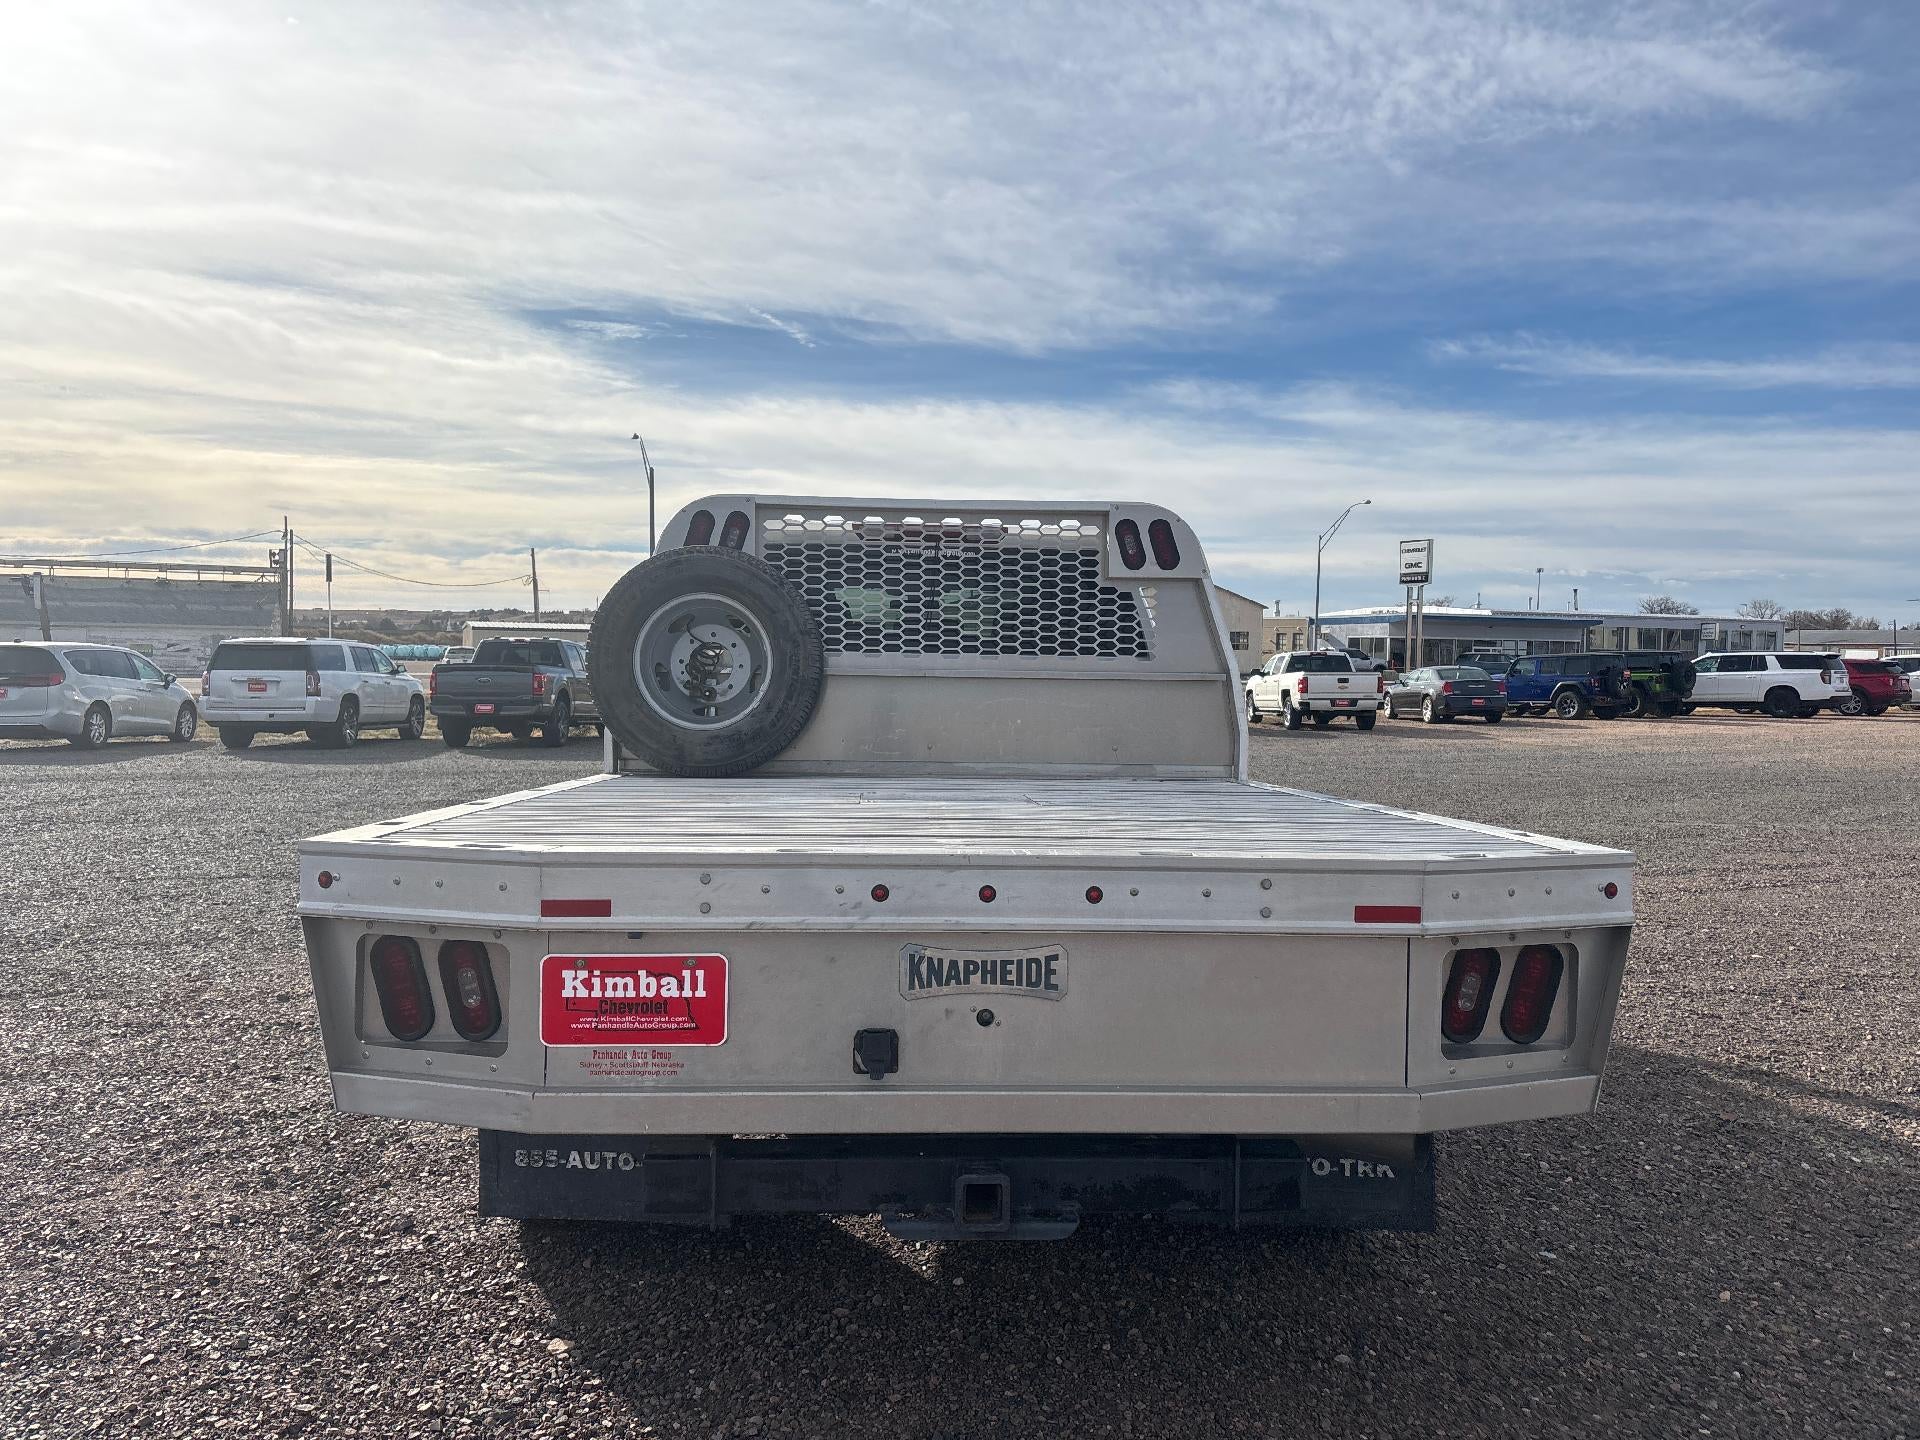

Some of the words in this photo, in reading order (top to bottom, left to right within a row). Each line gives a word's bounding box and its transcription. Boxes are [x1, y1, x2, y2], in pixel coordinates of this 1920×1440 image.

[908, 954, 1059, 991] KNAPHEIDE
[561, 969, 707, 998] Kimball
[599, 1000, 668, 1014] Chevrolet
[570, 1021, 696, 1030] www.PanhandleAutoGroup.com
[592, 1049, 628, 1060] Panhandle
[631, 1049, 648, 1060] Auto
[651, 1049, 672, 1061] Group
